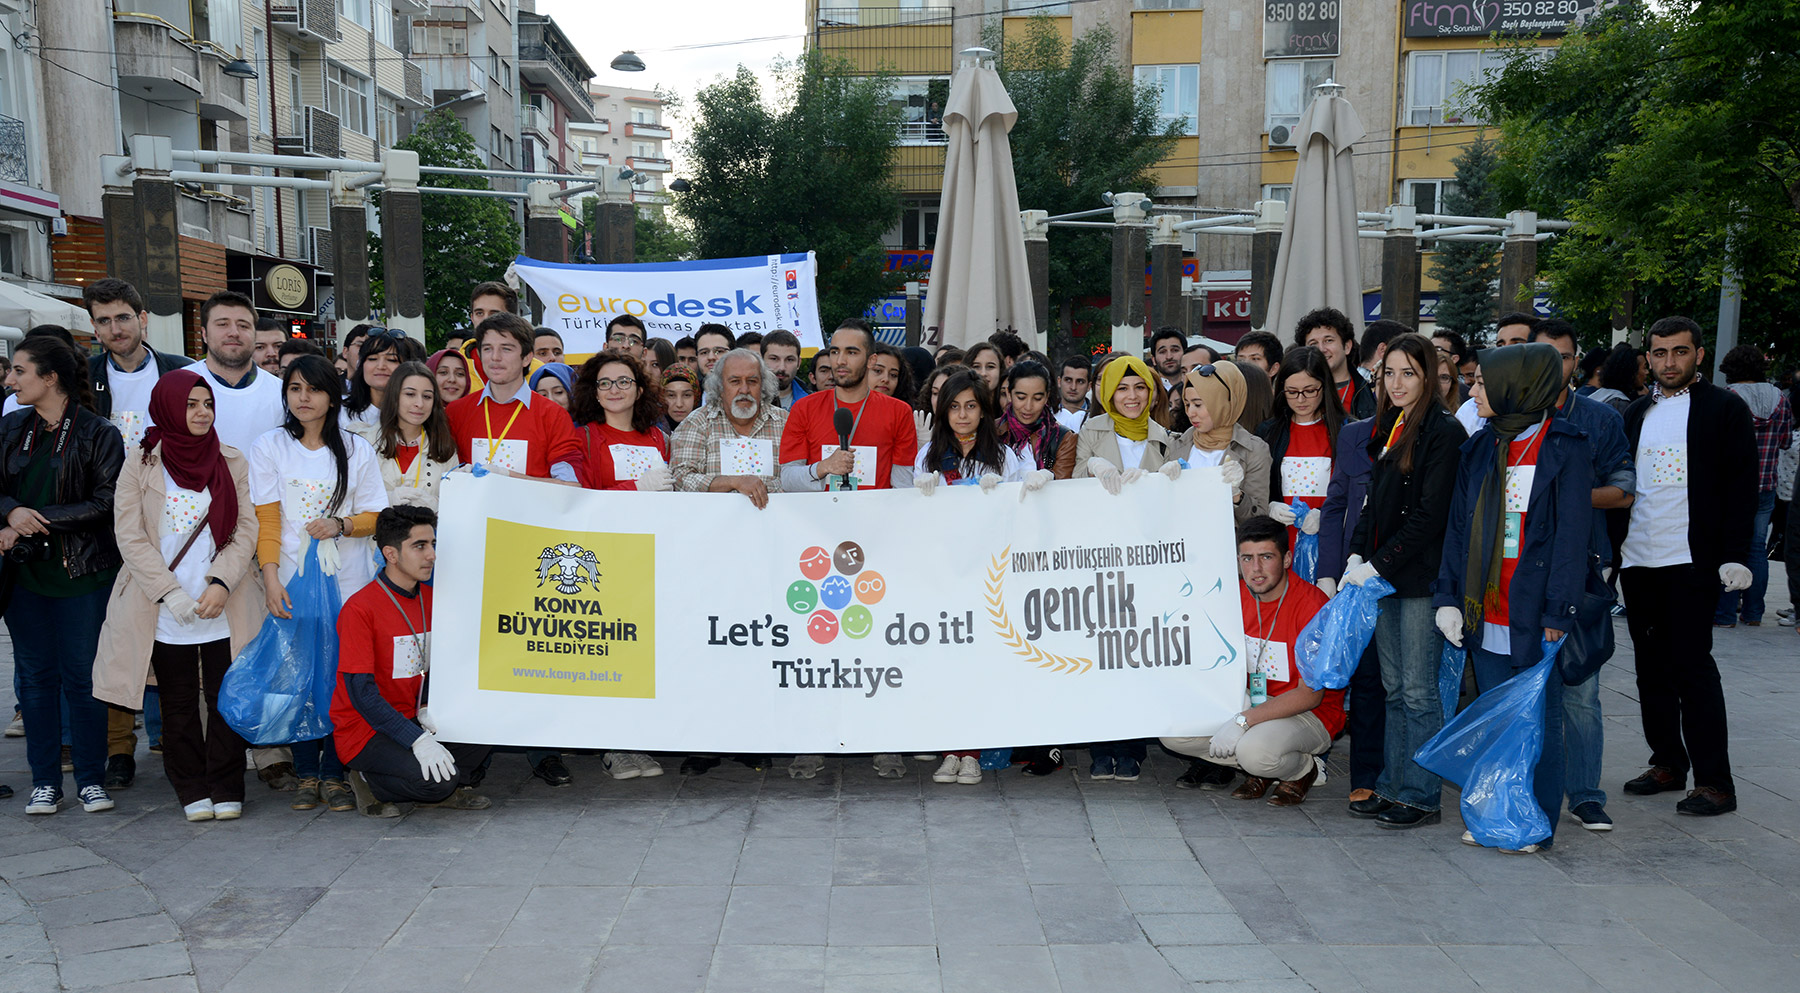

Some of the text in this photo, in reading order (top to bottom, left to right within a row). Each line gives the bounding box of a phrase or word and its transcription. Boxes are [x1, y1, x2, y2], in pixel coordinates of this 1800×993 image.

[1268, 1, 1337, 21] 350 82 80
[1410, 2, 1471, 26] ftm
[1503, 0, 1579, 16] 350 82 80
[1438, 25, 1452, 34] Saç
[1289, 34, 1321, 47] ftm
[558, 290, 764, 318] eurodesk
[701, 321, 767, 331] Nktası
[63, 418, 71, 430] EOS
[56, 431, 67, 453] DIGITAL
[1012, 538, 1186, 573] KONYA BÜYÜKŞEHİR BELEDİYESİ
[534, 596, 603, 616] KONYA
[1024, 571, 1137, 641] gençlik
[498, 612, 637, 642] BÜYÜKŞEHİR
[708, 611, 974, 647] Let's do it!
[526, 640, 609, 656] BELEDİYESİ
[513, 667, 623, 683] www.konya.bel.tr
[772, 658, 903, 698] Türkiye
